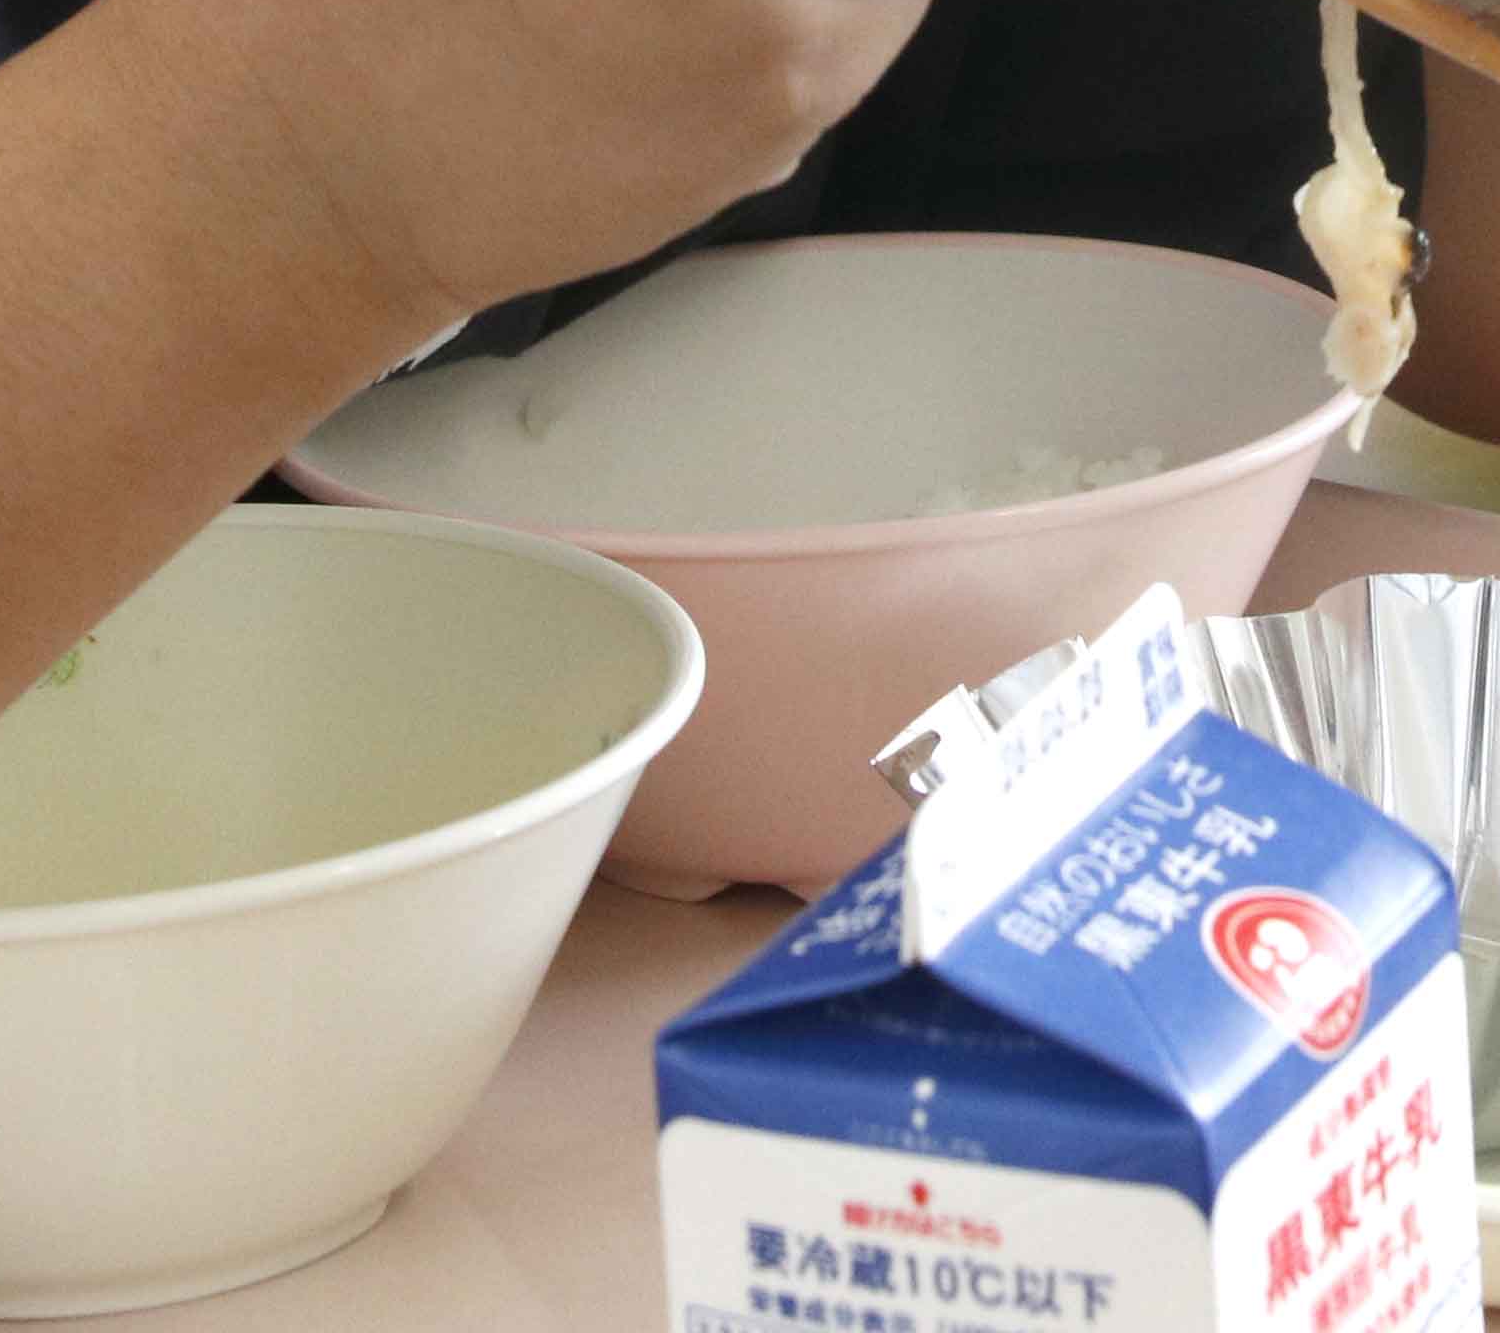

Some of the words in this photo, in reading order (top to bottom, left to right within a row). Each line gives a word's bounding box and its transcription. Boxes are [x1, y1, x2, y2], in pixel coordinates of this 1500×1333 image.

[996, 753, 1225, 956] 自然のおいしさ
[1073, 804, 1279, 972] 黒東牛乳
[745, 1220, 1114, 1321] 要冷蔵10℃以下
[1265, 1078, 1442, 1315] 黒東牛乳
